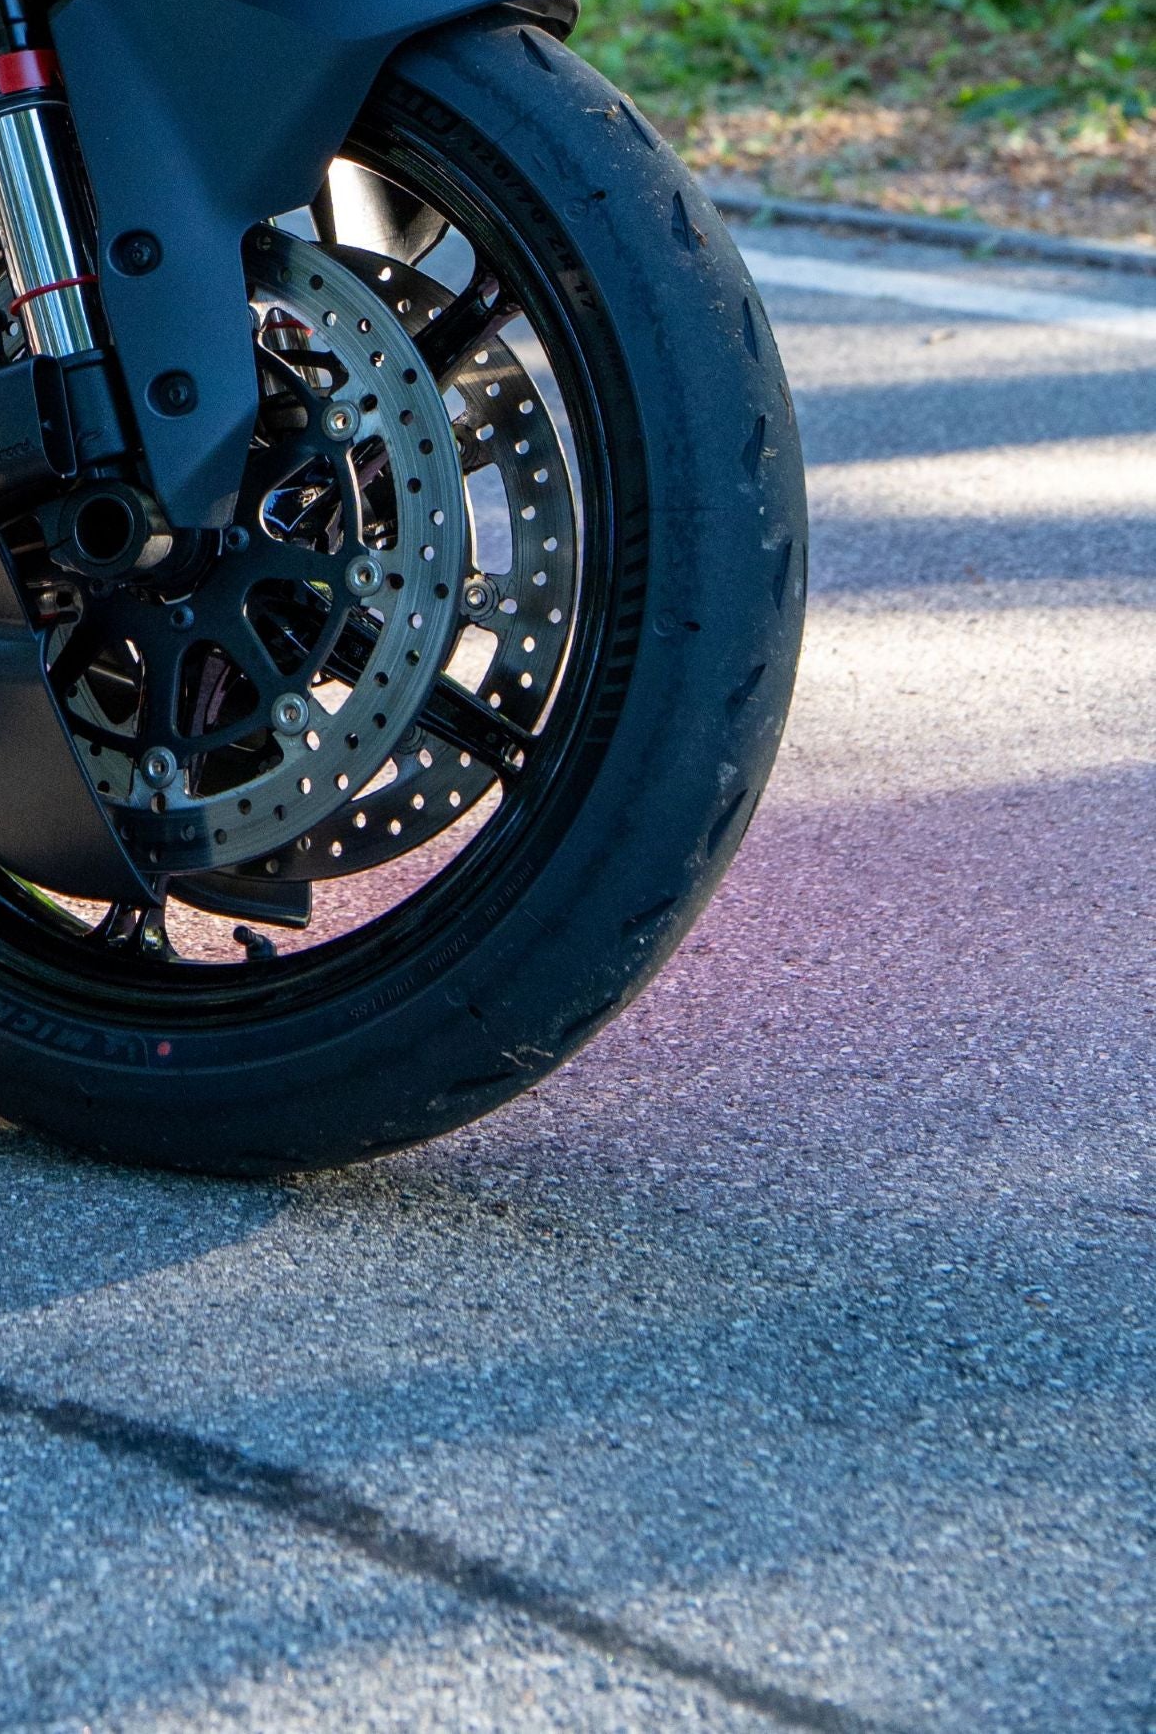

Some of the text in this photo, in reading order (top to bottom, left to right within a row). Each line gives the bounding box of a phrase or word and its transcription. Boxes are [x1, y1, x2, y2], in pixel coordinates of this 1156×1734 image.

[464, 135, 598, 318] 120/70 ZR 17
